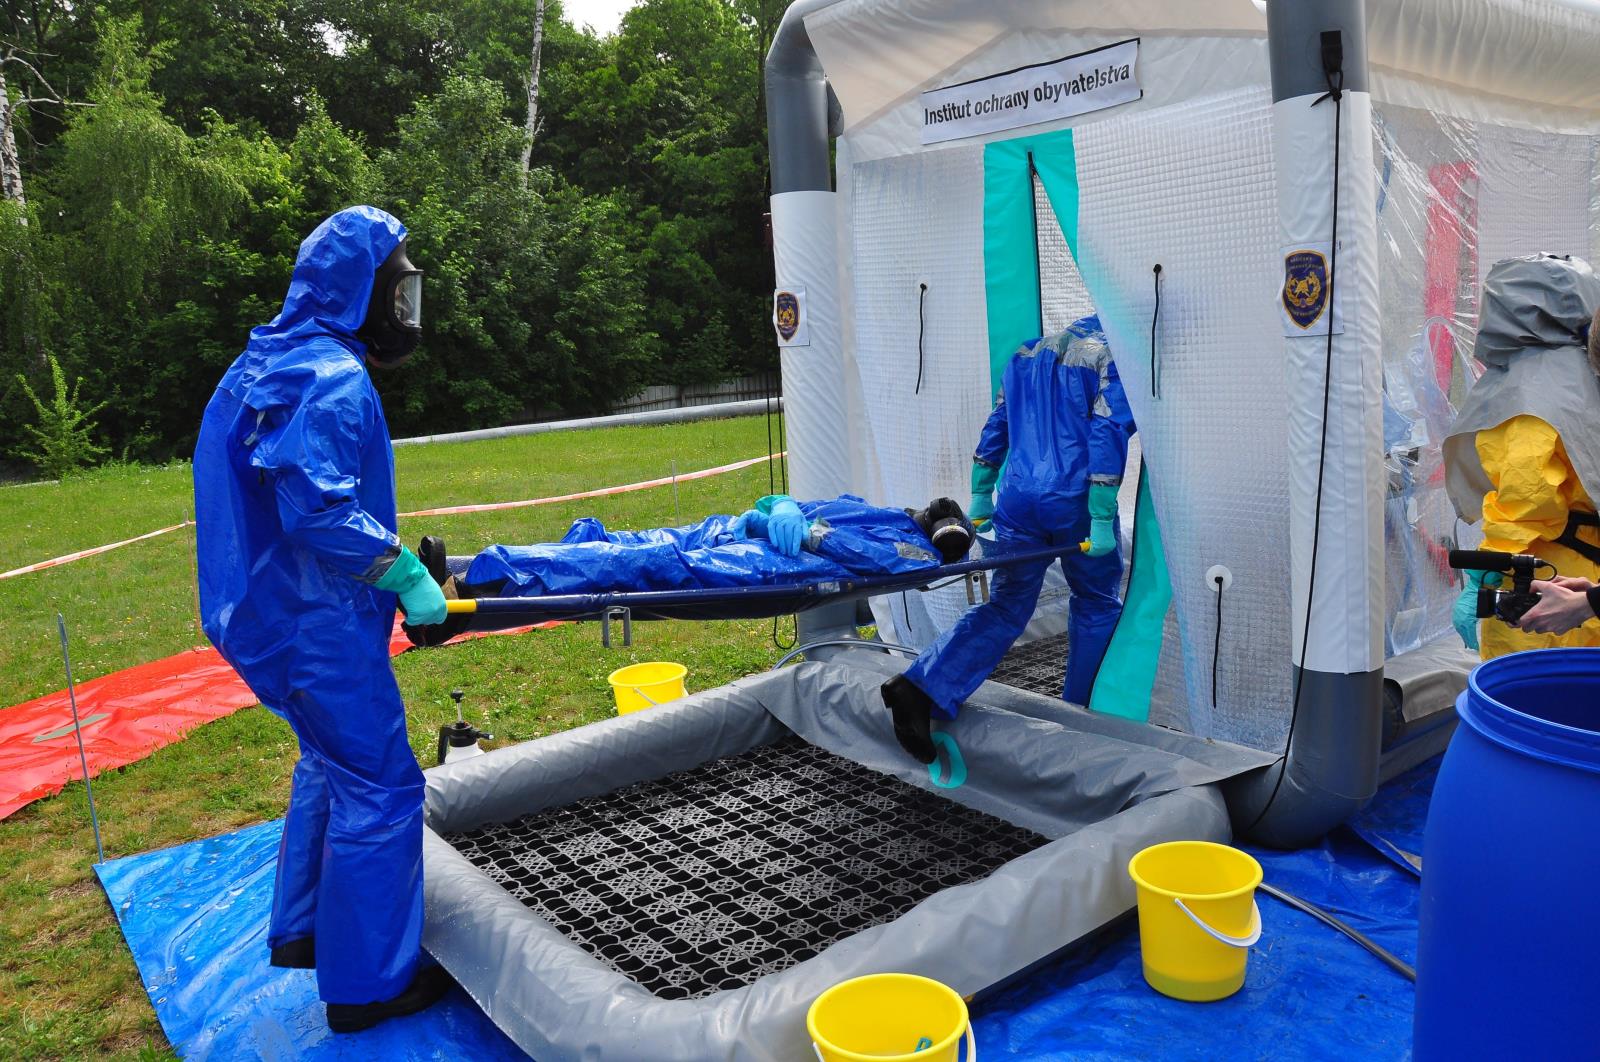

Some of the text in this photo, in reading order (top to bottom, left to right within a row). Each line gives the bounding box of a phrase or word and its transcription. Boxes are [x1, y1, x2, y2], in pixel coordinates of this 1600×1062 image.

[924, 63, 1130, 126] Institut ochrany obyvatelstva
